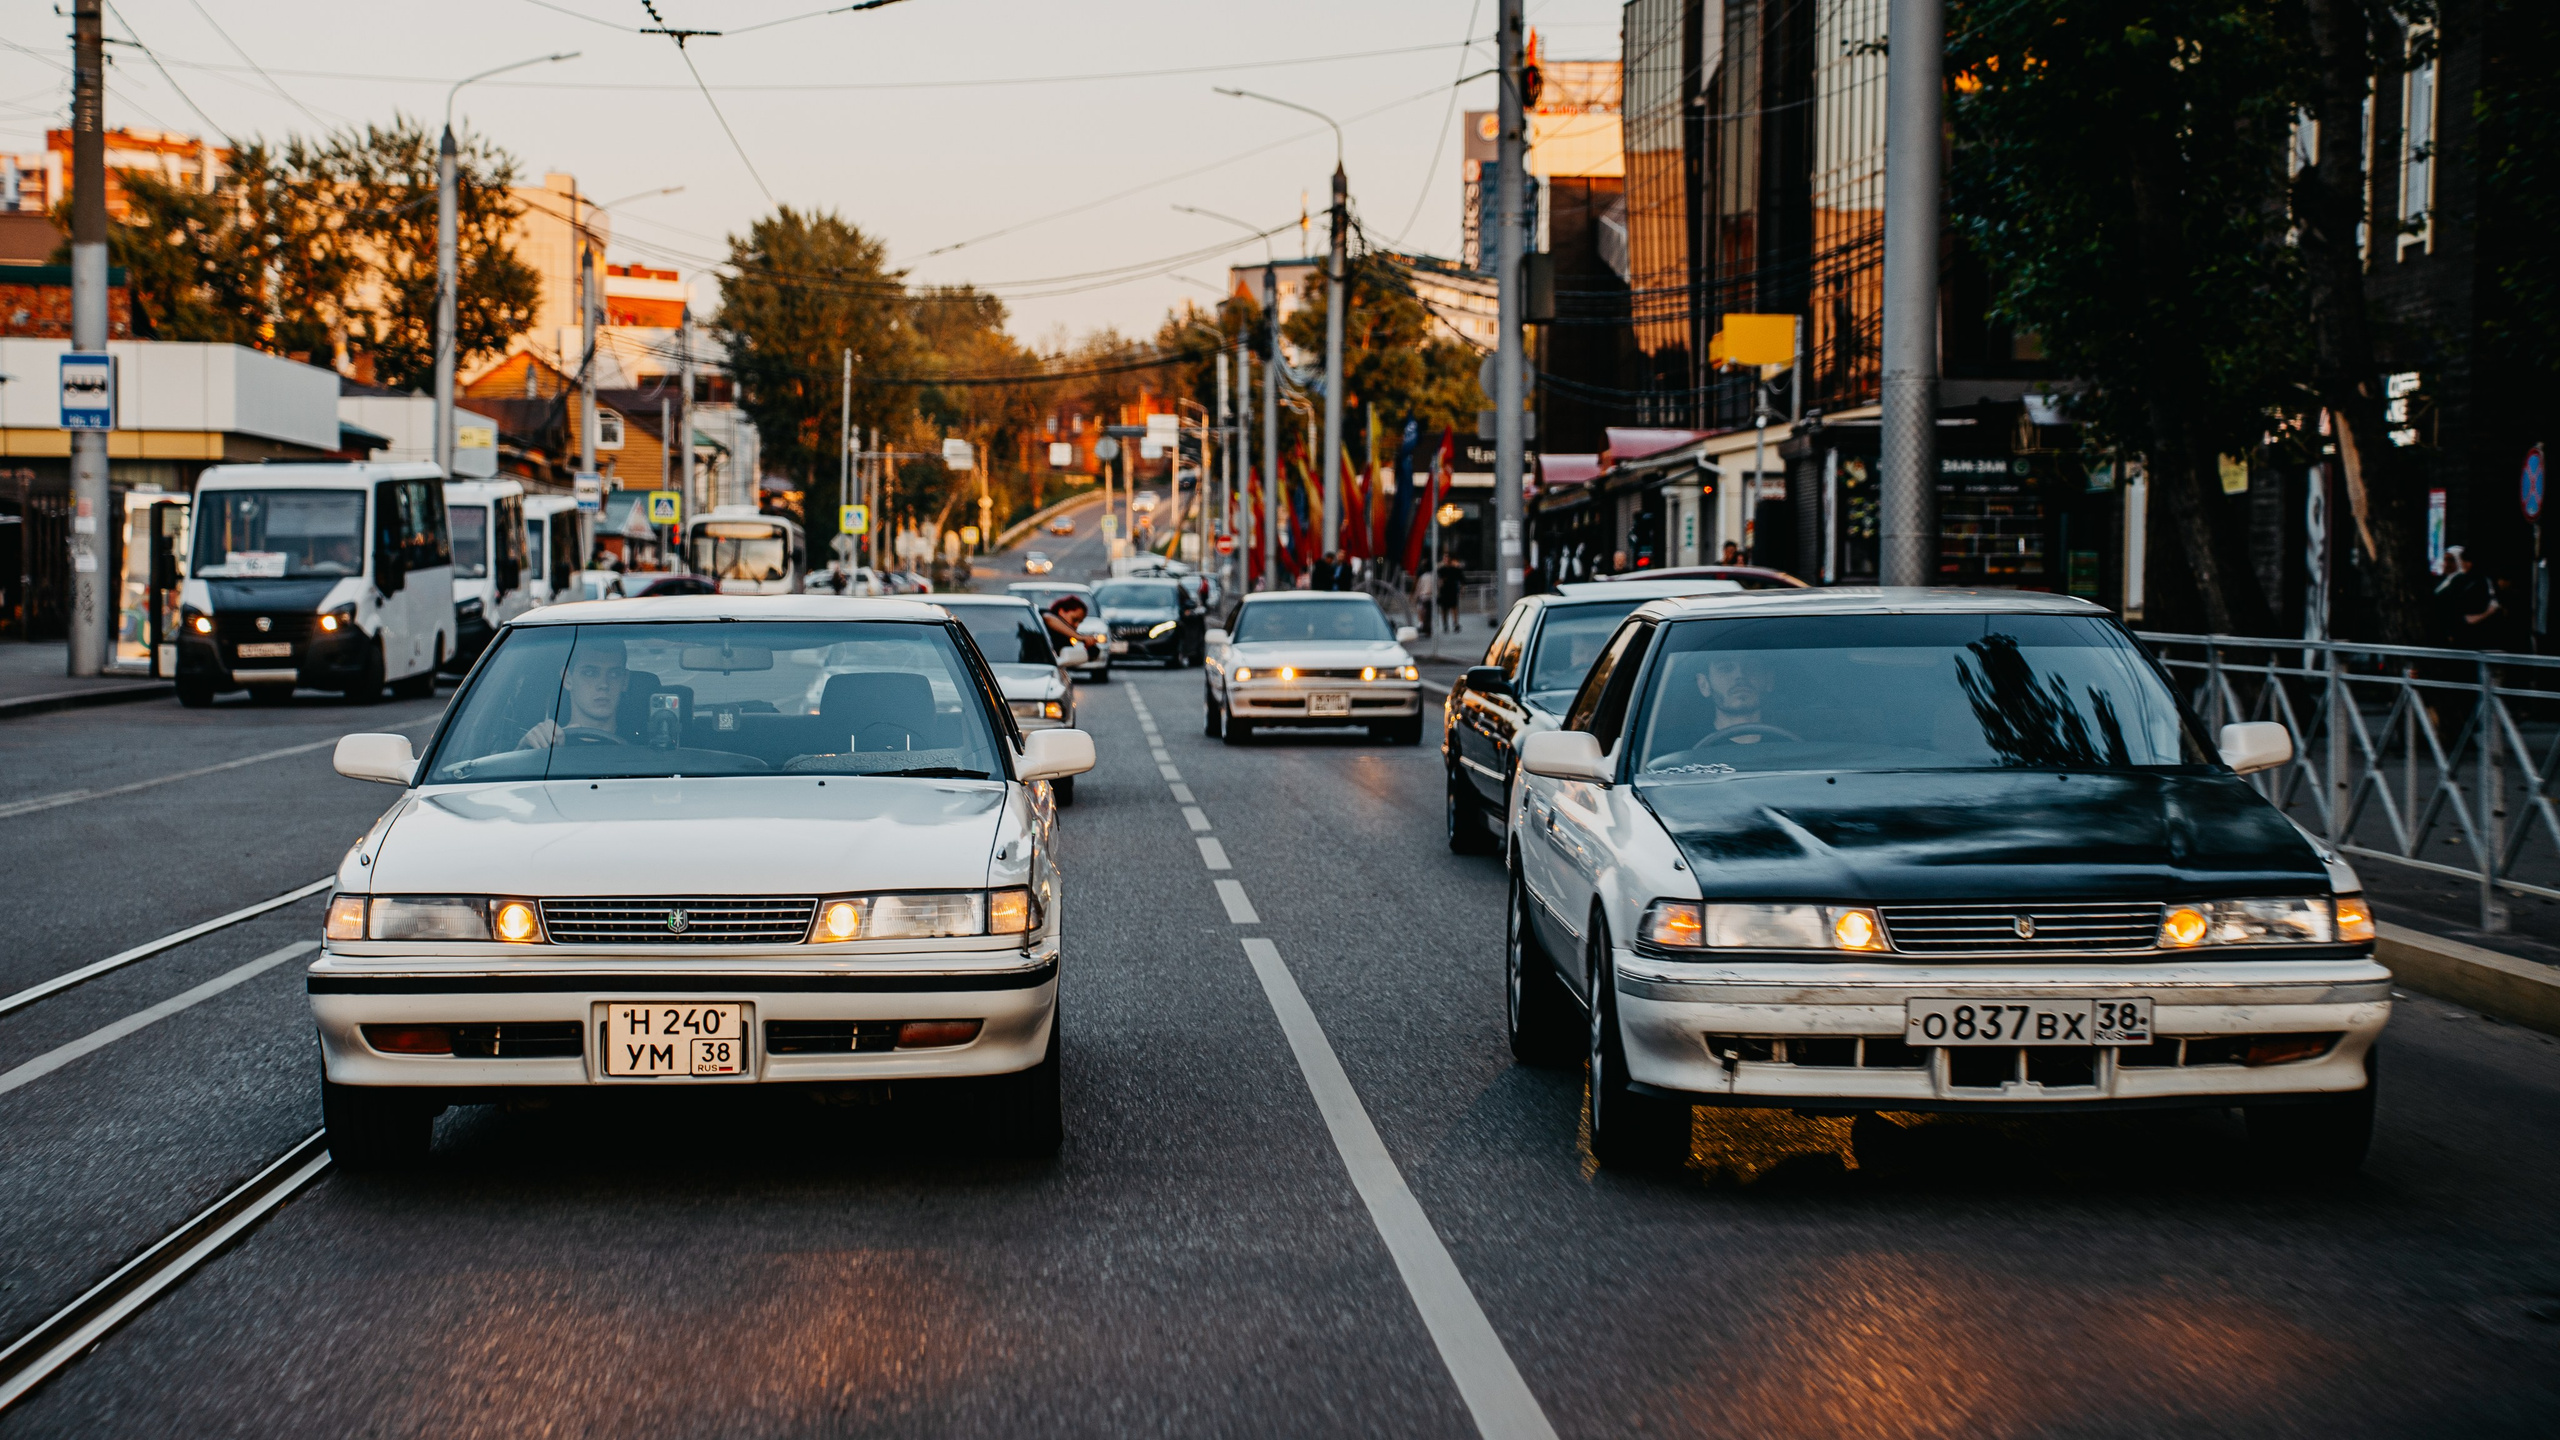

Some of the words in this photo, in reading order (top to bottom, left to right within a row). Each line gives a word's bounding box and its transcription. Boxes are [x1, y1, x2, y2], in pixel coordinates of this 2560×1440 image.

[630, 1009, 650, 1035] Н
[663, 1009, 720, 1035] 240
[1922, 1004, 2086, 1041] О837ВХ
[2097, 1002, 2137, 1030] 38
[2094, 1029, 2126, 1041] RUS
[626, 1043, 673, 1070] УМ
[701, 1042, 730, 1063] 38
[697, 1064, 718, 1072] RUS
